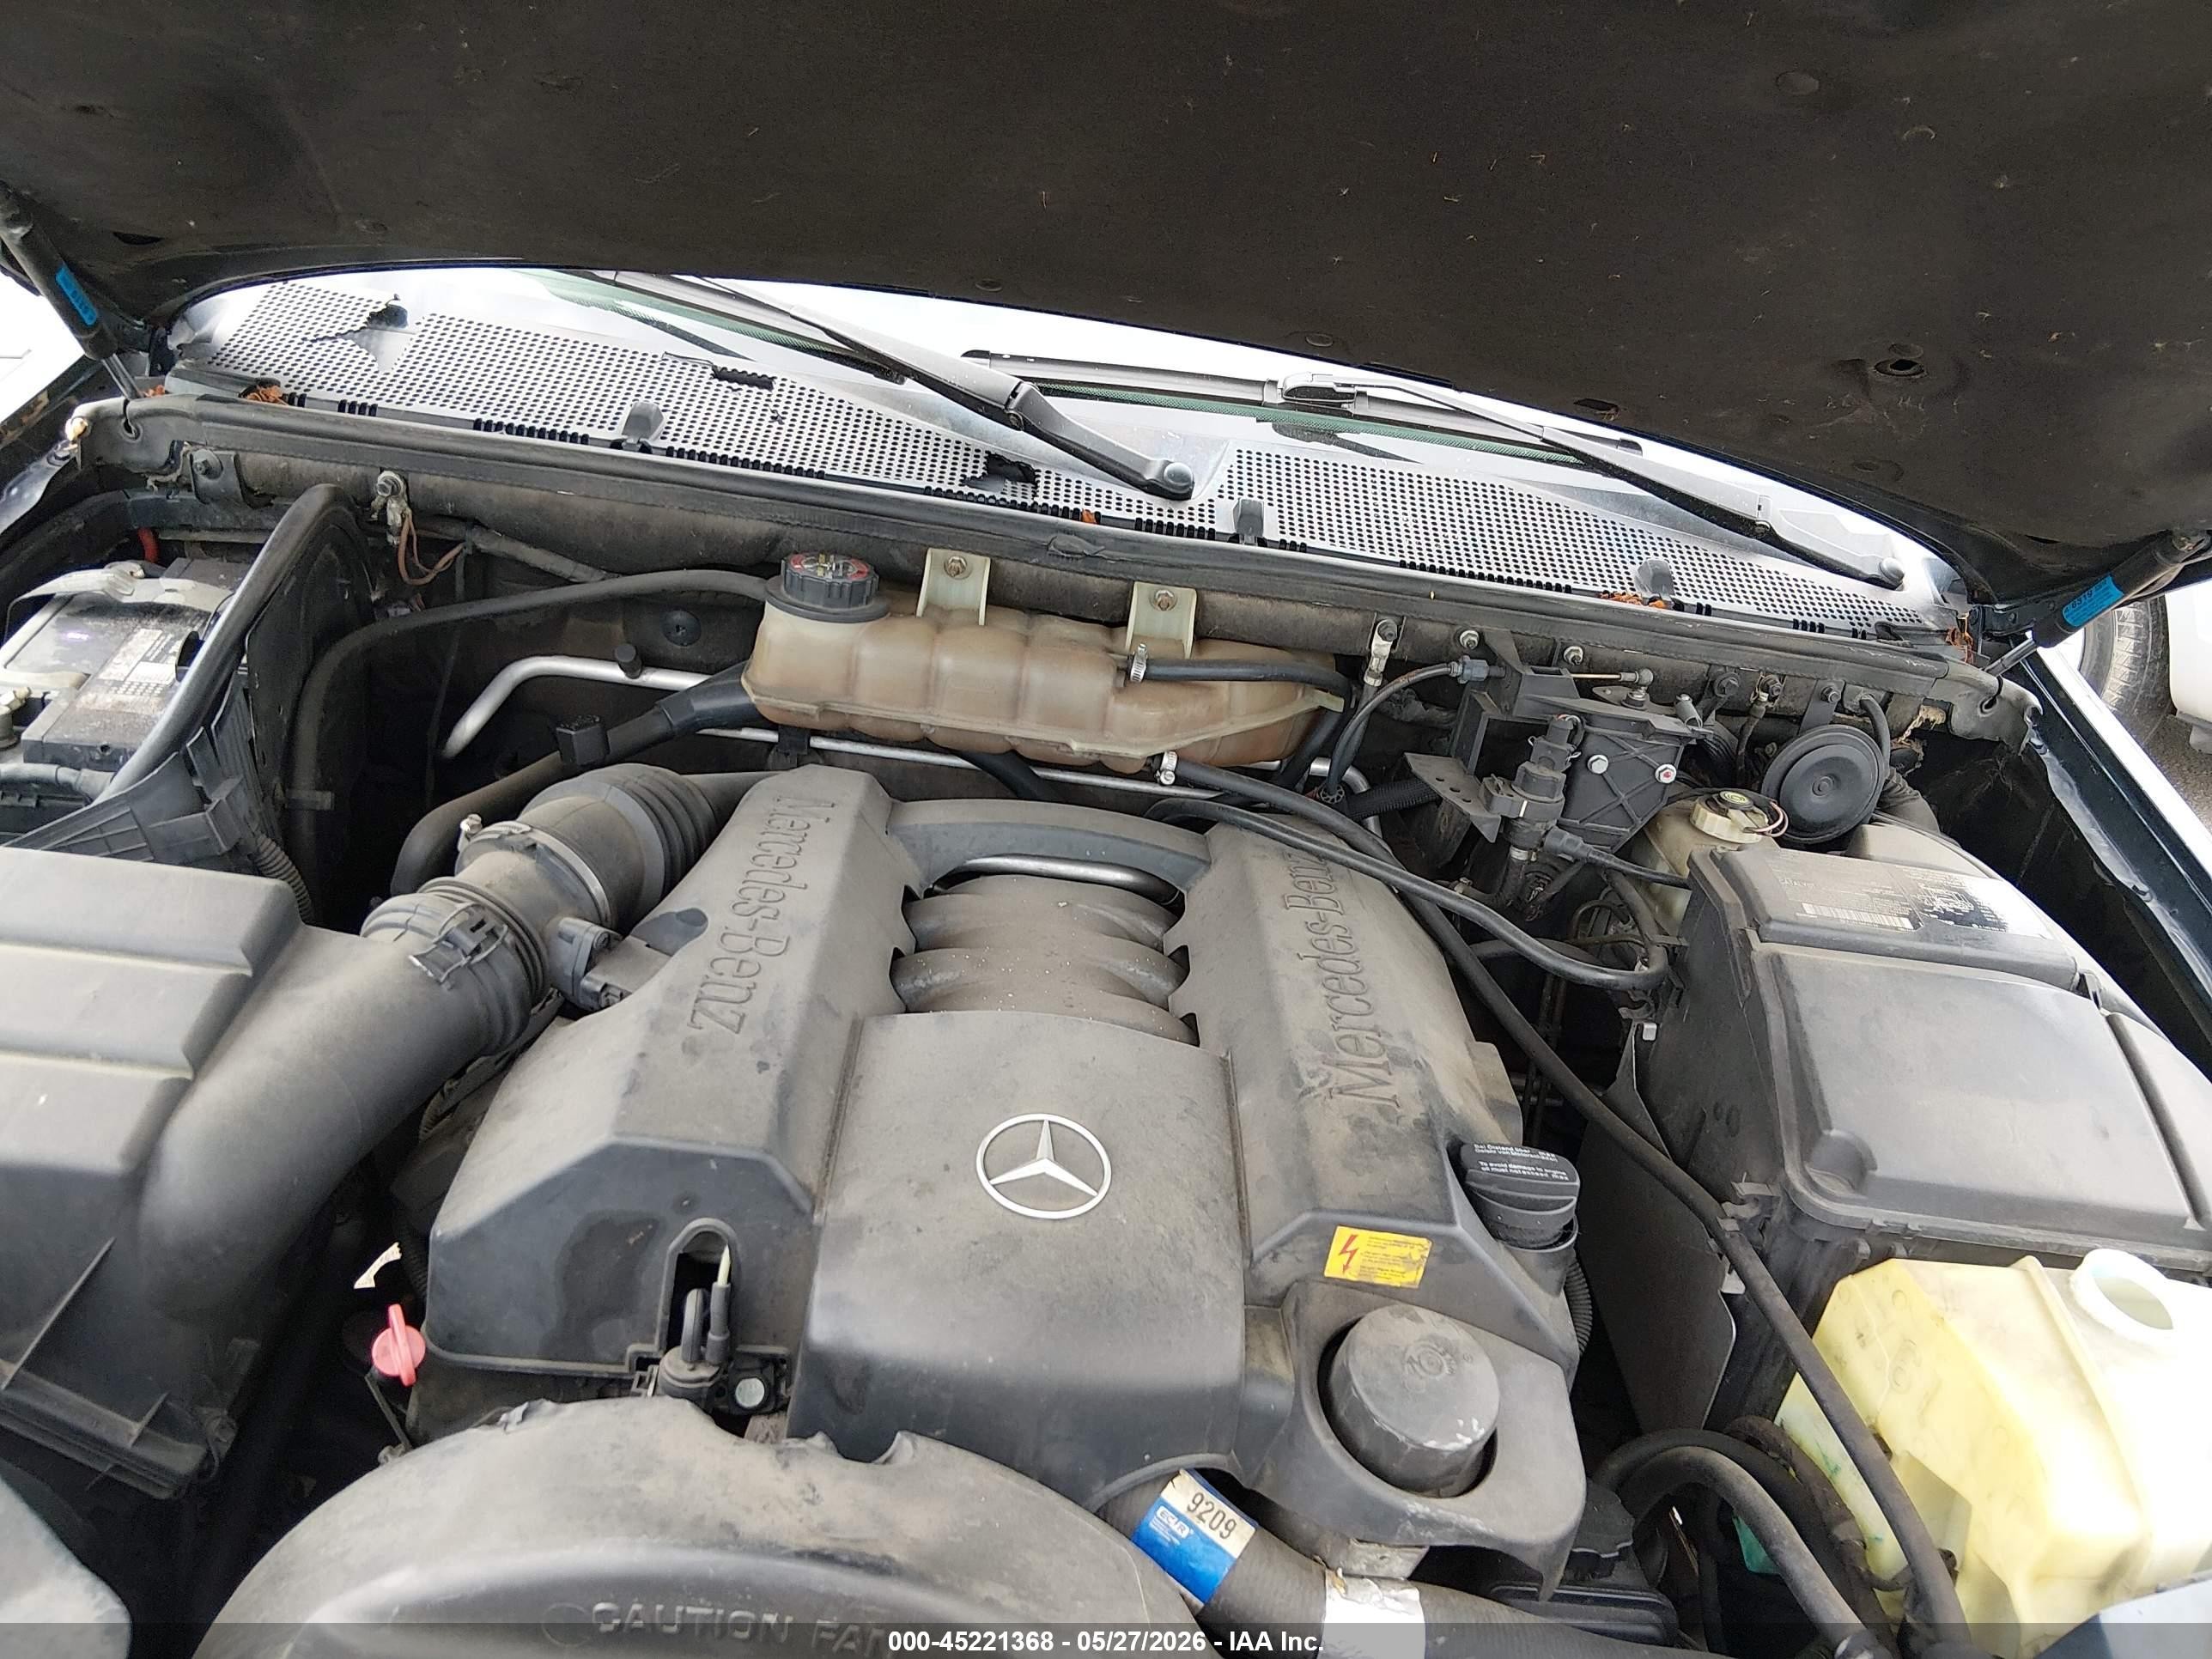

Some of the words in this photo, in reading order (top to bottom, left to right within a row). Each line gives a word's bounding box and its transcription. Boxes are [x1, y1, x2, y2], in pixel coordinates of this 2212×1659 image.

[687, 797, 836, 1035] Mercedes-Benz
[1187, 1492, 1237, 1540] 9209
[592, 1602, 793, 1644] CAUTION
